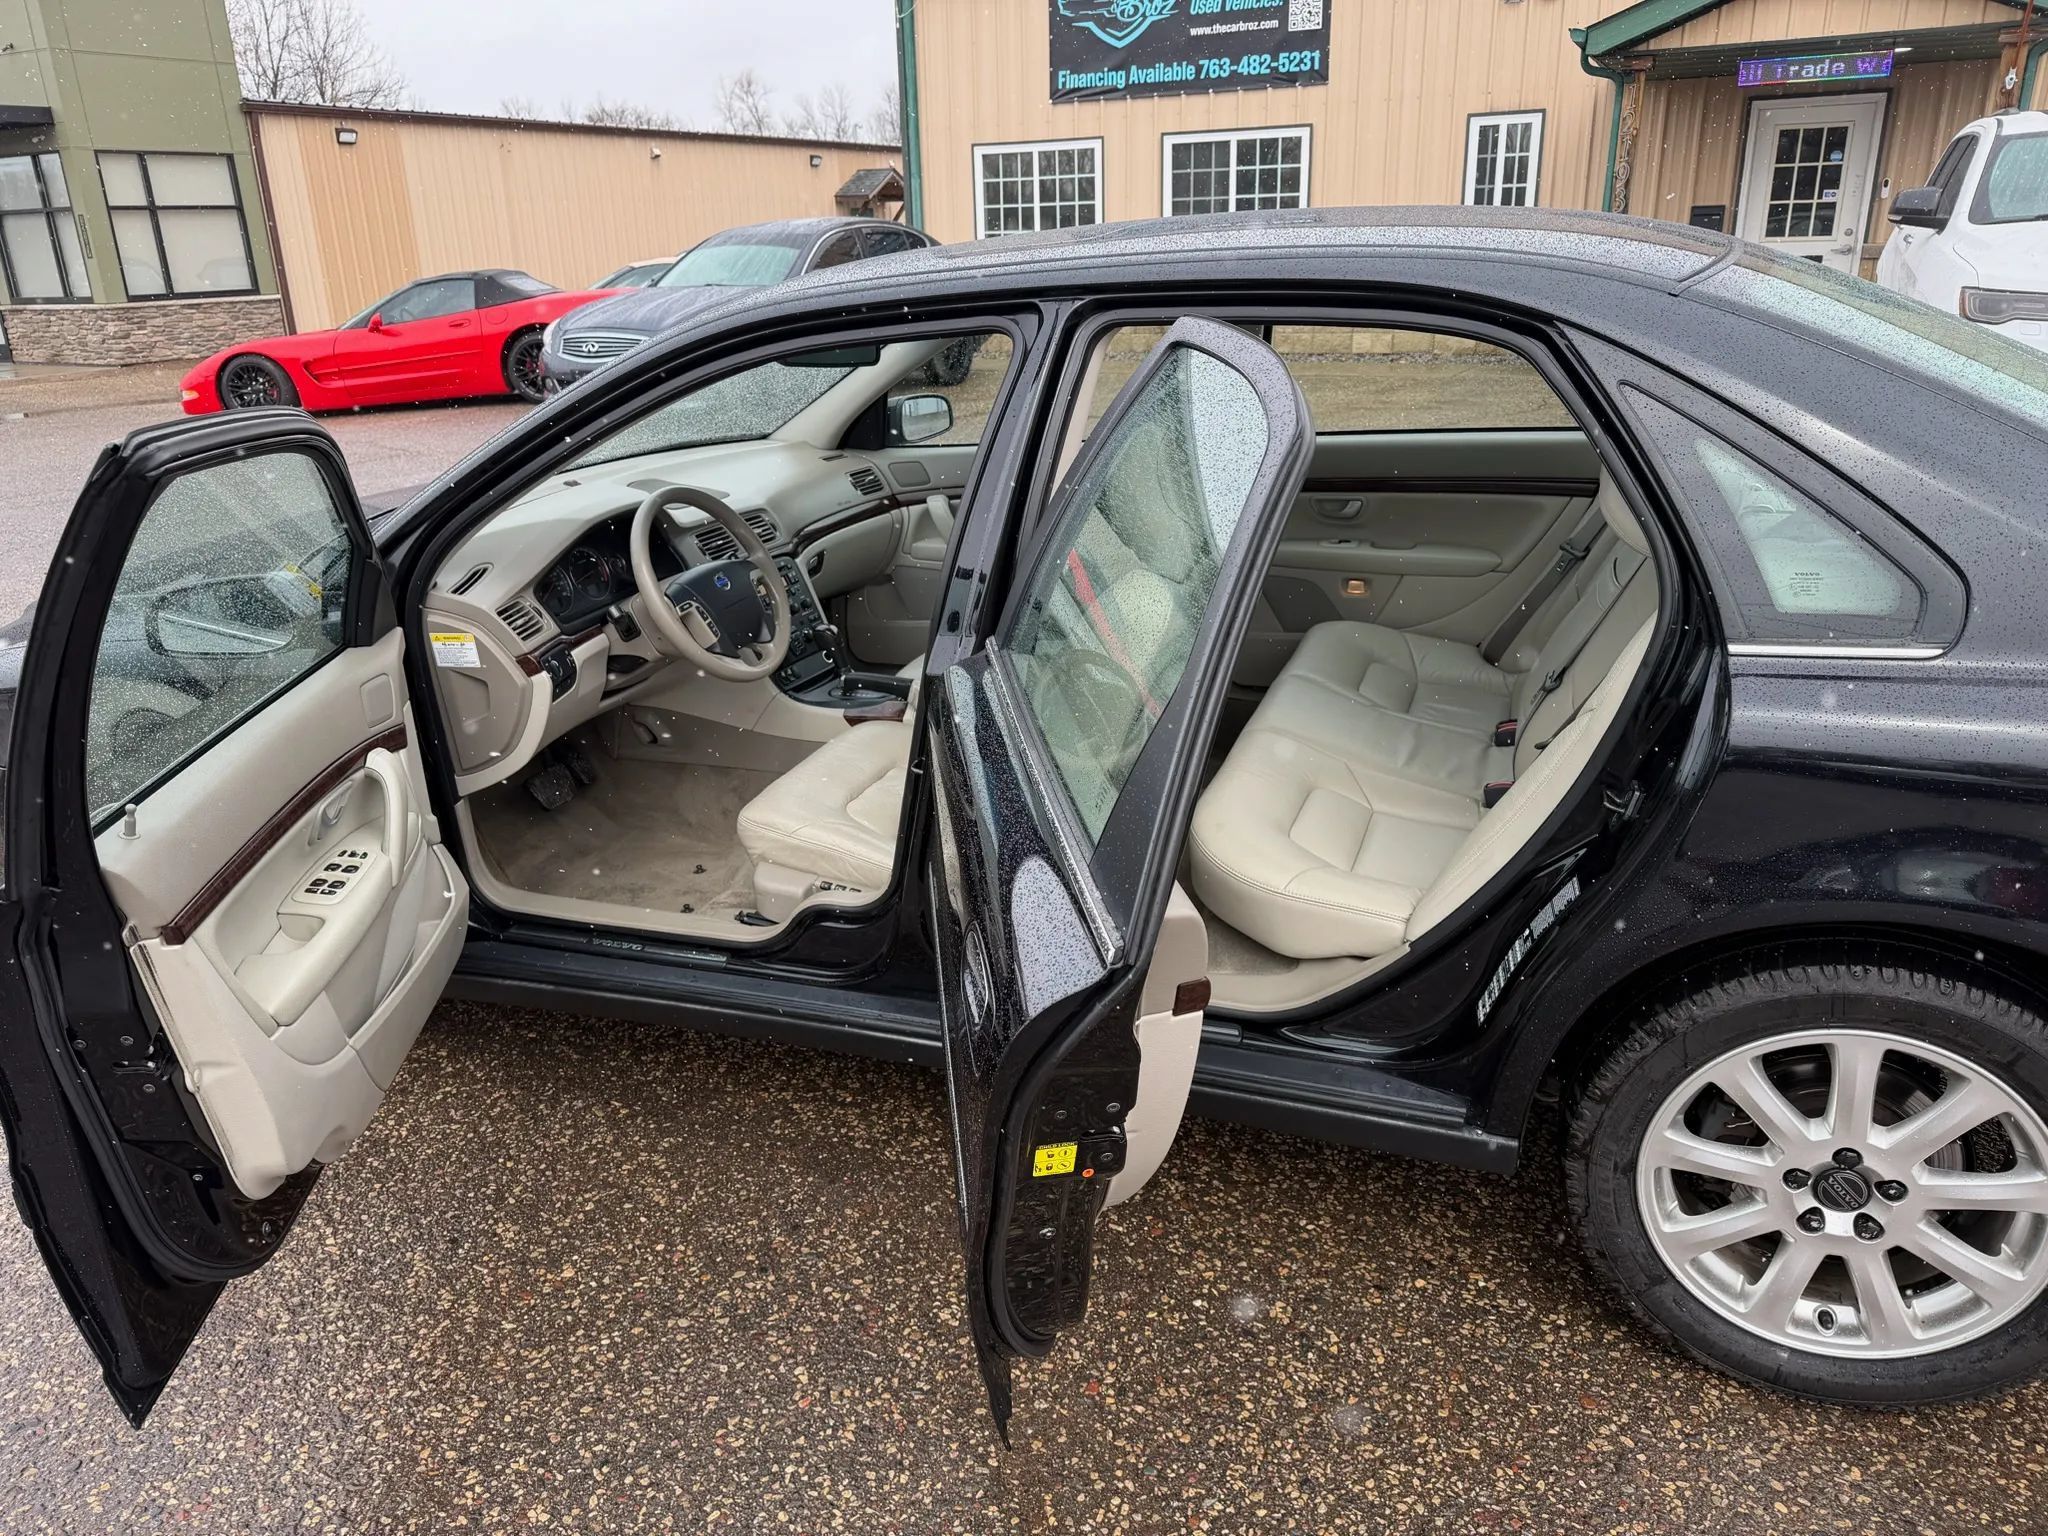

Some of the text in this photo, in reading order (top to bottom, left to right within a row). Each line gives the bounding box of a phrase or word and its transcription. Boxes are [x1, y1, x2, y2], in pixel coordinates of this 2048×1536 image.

[1190, 20, 1279, 36] www.thecarbroz.com
[1057, 50, 1321, 89] Financing Available 763-482-5231
[1774, 60, 1846, 79] Trade
[1613, 84, 1637, 213] 12193
[1828, 1175, 1859, 1209] VOLVO
